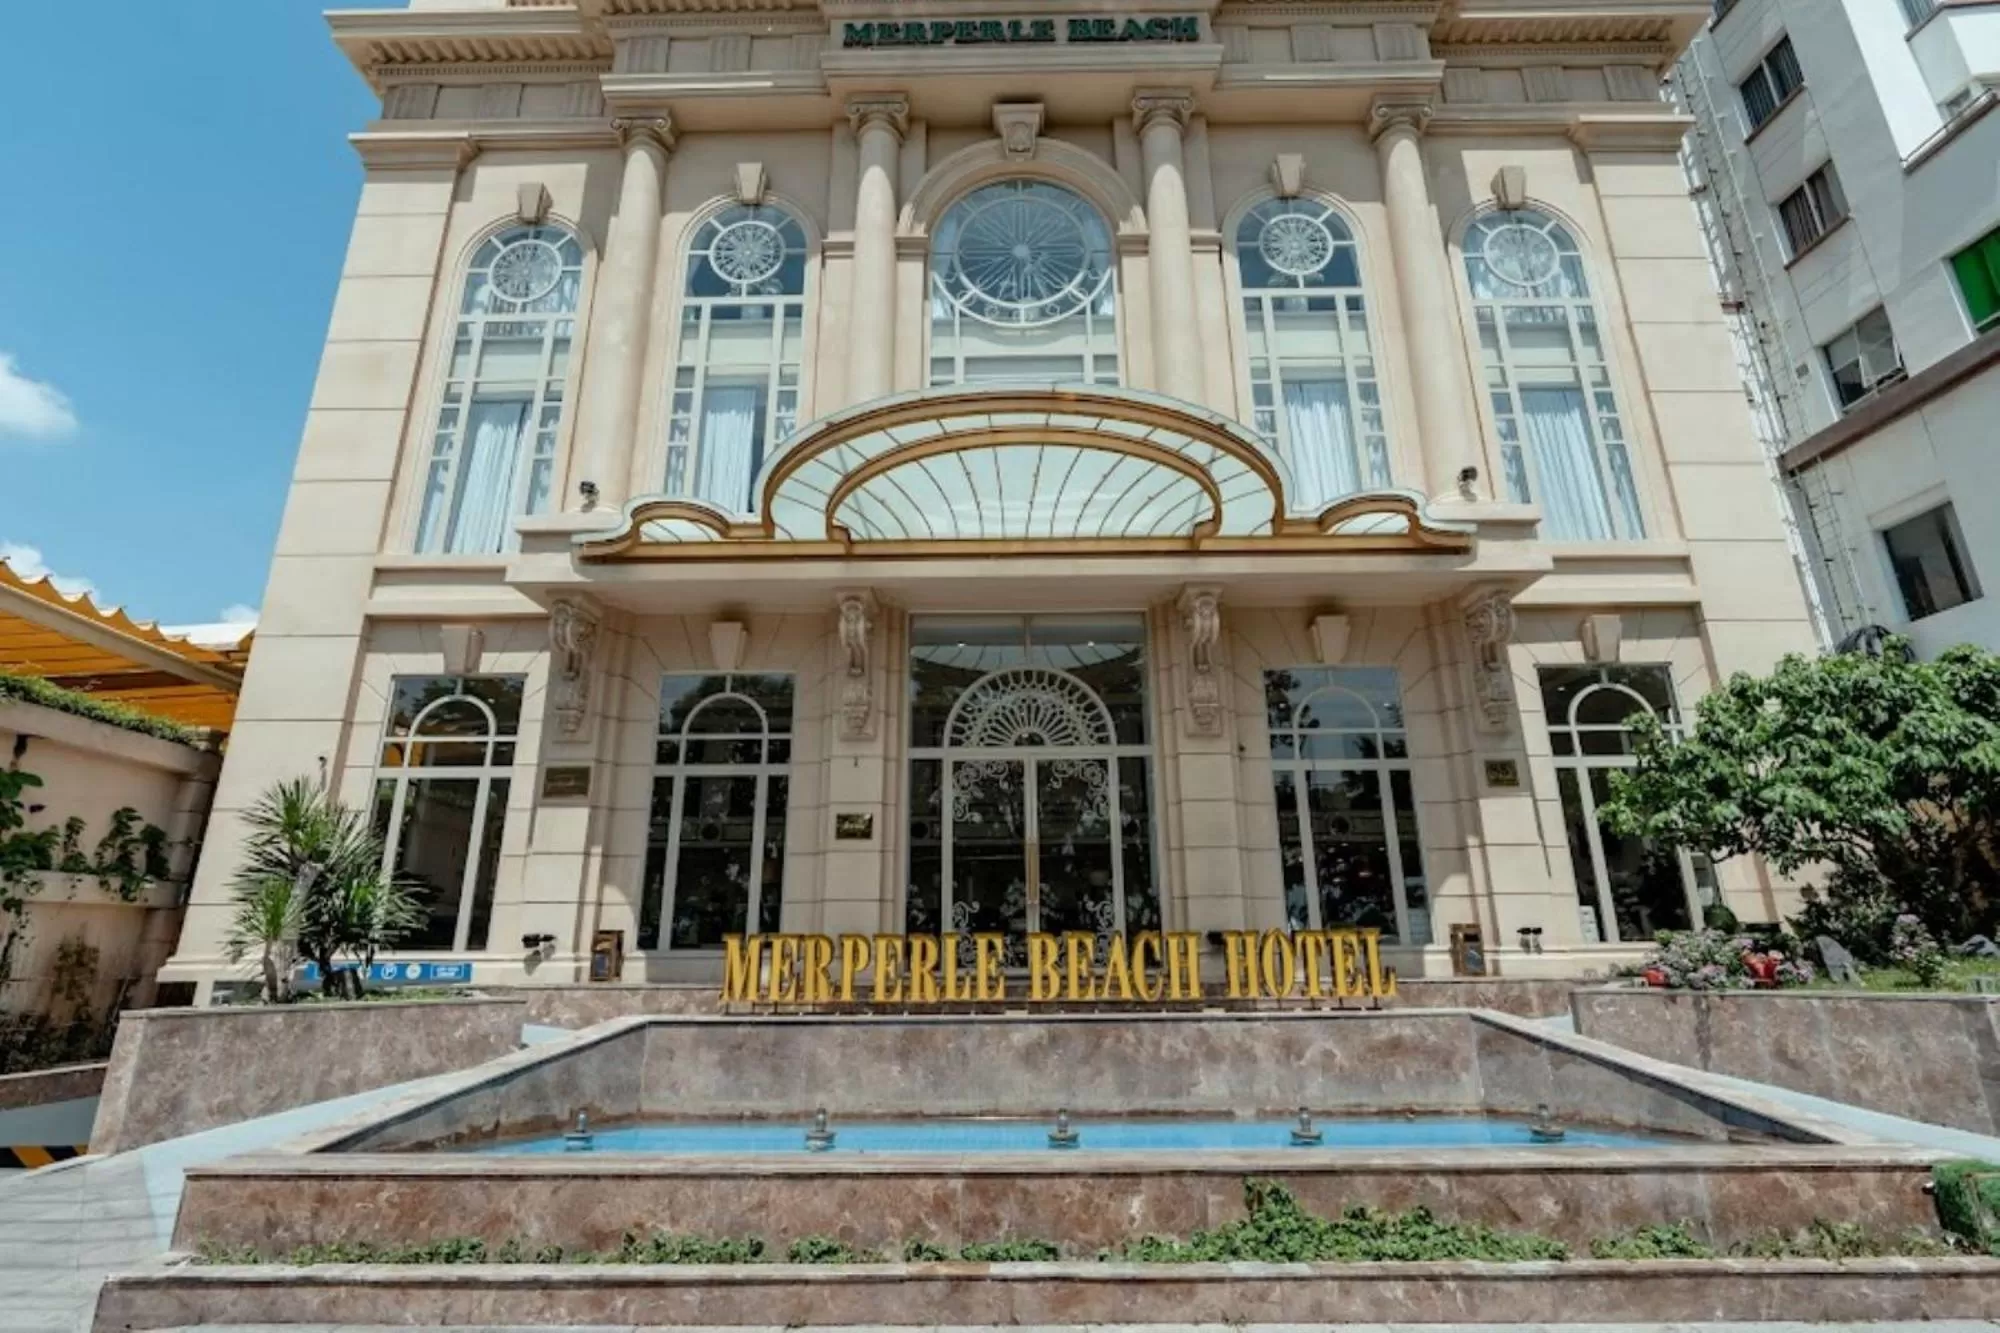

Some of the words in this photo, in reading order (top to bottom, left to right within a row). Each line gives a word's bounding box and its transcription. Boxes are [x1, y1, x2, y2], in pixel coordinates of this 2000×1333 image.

[843, 18, 1055, 46] MERPERLE
[1067, 17, 1199, 42] BEACH
[722, 932, 1005, 1003] MERPERLE
[1027, 929, 1201, 1001] BEACH
[1222, 927, 1397, 999] HOTEL
